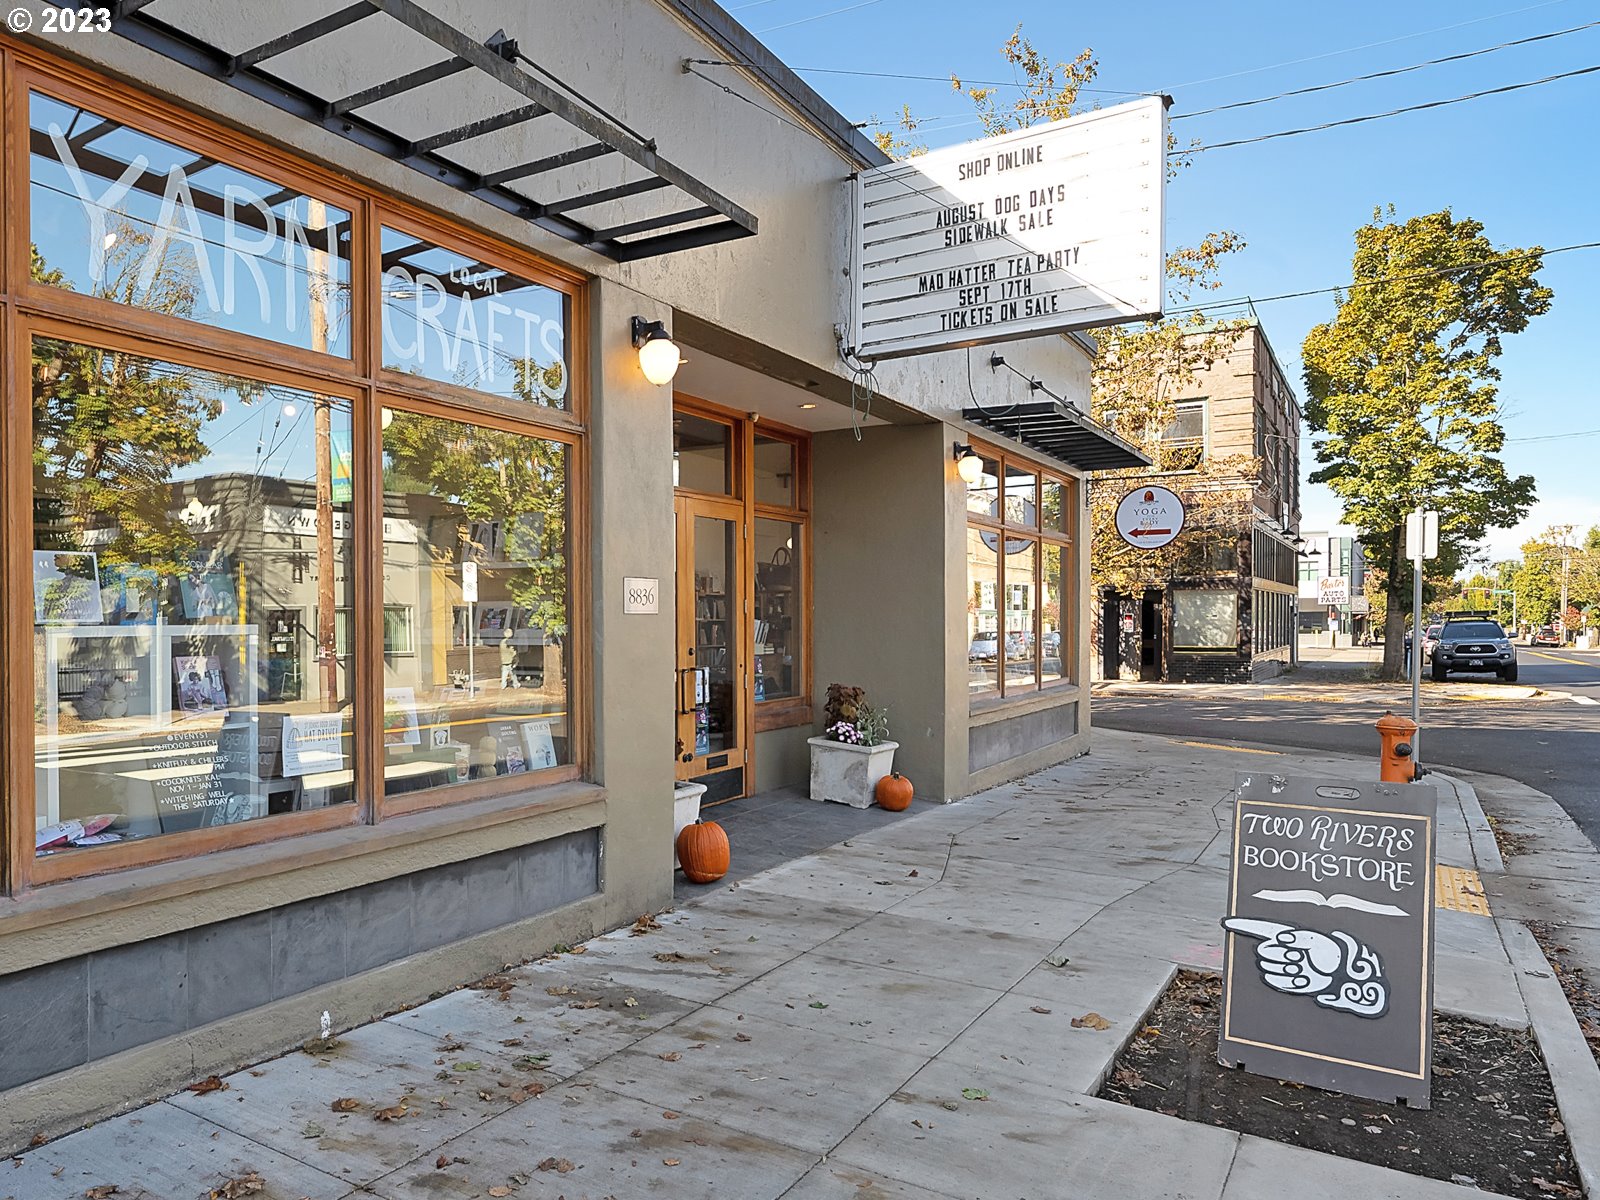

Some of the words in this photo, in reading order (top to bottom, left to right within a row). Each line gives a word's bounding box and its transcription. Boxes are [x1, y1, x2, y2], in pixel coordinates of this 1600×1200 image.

[959, 158, 991, 181] SHOP
[997, 145, 1043, 172] ONLINE
[936, 202, 984, 229] AUGUST
[995, 195, 1020, 216] DOG
[1030, 184, 1065, 208] DAYS
[48, 123, 342, 342] YARN
[945, 217, 1008, 246] SIDEWALK
[1019, 208, 1053, 232] SALE
[450, 264, 503, 297] LOCAL
[918, 273, 943, 293] MAD
[949, 263, 996, 287] HATTER
[1008, 257, 1031, 277] TEA
[1037, 247, 1080, 271] PARTY
[959, 285, 989, 306] SEPT
[1000, 278, 1031, 298] 17TH
[940, 307, 993, 331] TICKETS
[1000, 301, 1017, 322] ON
[1025, 295, 1058, 316] SALE
[381, 266, 568, 400] CRAFTS
[1133, 507, 1167, 516] YOGA
[628, 585, 654, 606] 8836
[153, 741, 192, 752] OUTDOOR
[192, 739, 218, 749] STITCH
[198, 755, 229, 764] CHILLERS
[161, 776, 202, 787] COCOKNITS
[204, 774, 220, 783] KAL
[169, 785, 186, 793] NOV
[198, 782, 212, 790] JAN
[164, 793, 205, 805] WITCHING
[208, 790, 226, 798] WELL
[173, 803, 189, 811] THIS
[193, 797, 229, 809] SATURDAY
[1242, 813, 1304, 839] TWO
[1311, 815, 1415, 858] RIVERS
[1243, 844, 1415, 891] BOOKSTORE
